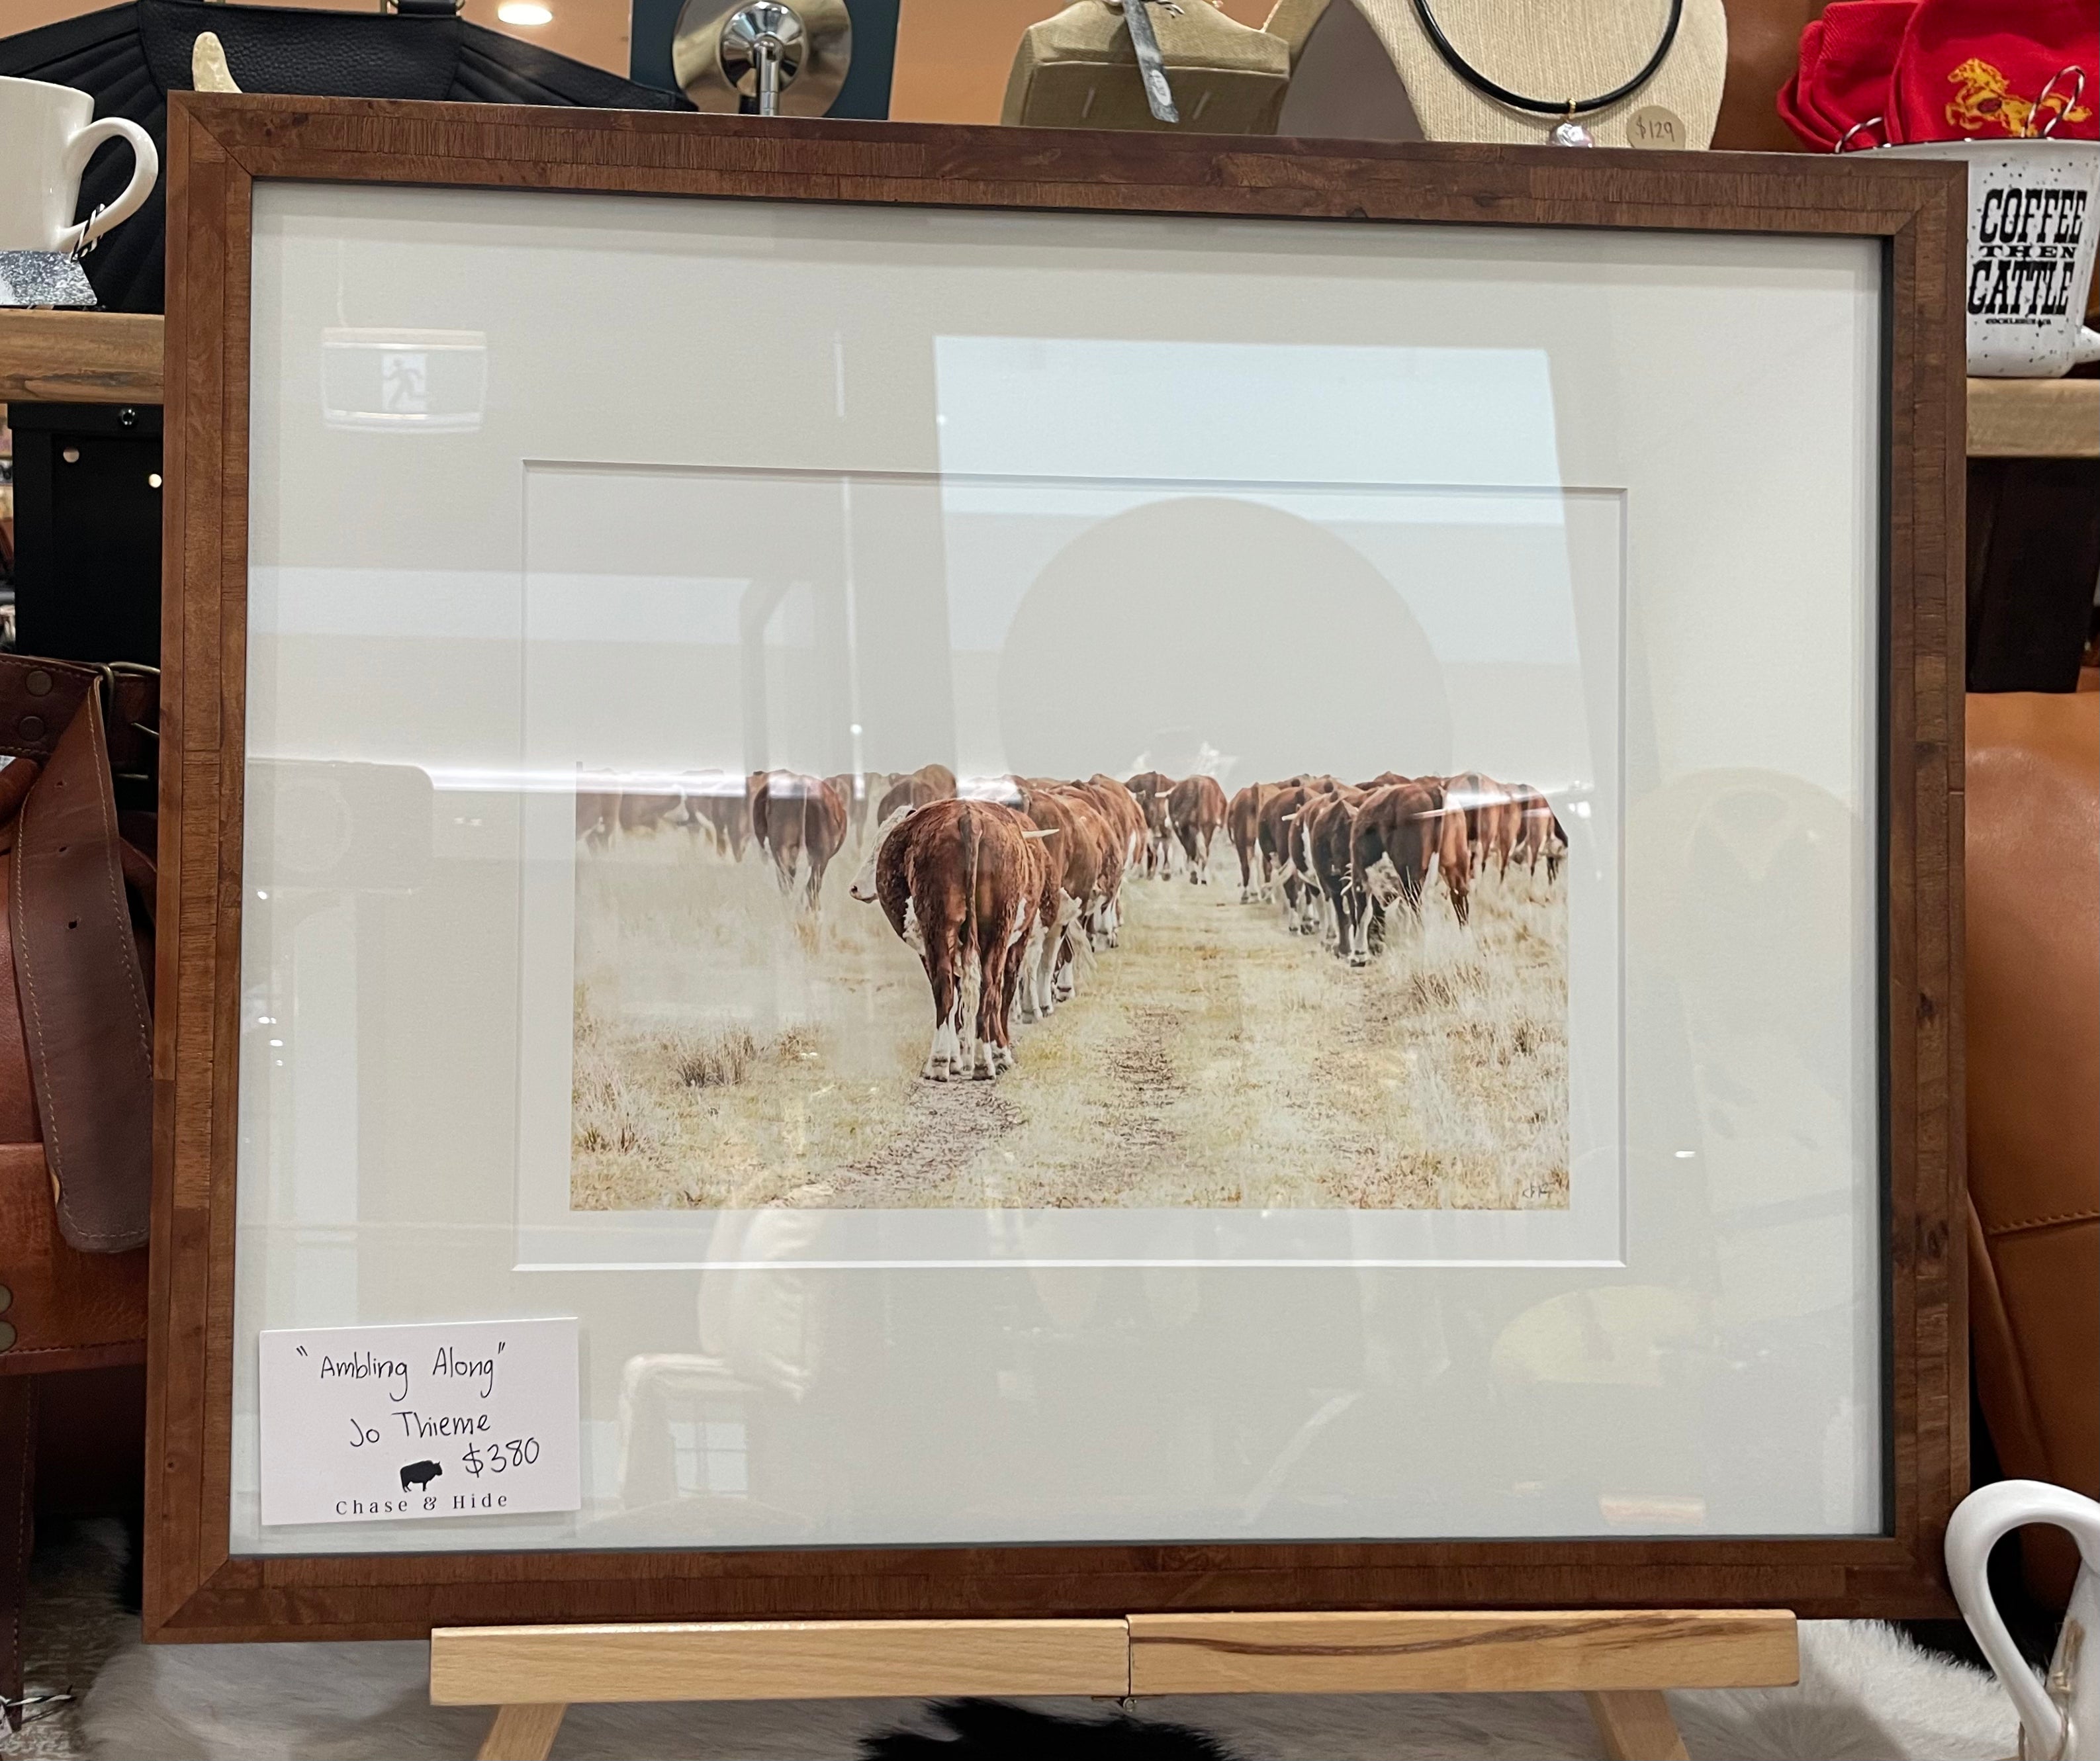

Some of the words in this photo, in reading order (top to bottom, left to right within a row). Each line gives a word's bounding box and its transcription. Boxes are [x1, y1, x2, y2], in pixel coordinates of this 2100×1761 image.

[1635, 115, 1675, 142] $129
[1980, 188, 2087, 244] COFFEE
[1979, 246, 2076, 258] THEN
[1968, 260, 2075, 315] CATTLE
[350, 1419, 380, 1447] Jo
[391, 1411, 490, 1439] Thieme
[462, 1437, 540, 1478] $380
[336, 1500, 408, 1515] Chase
[424, 1497, 437, 1511] &
[453, 1493, 508, 1510] Hide
